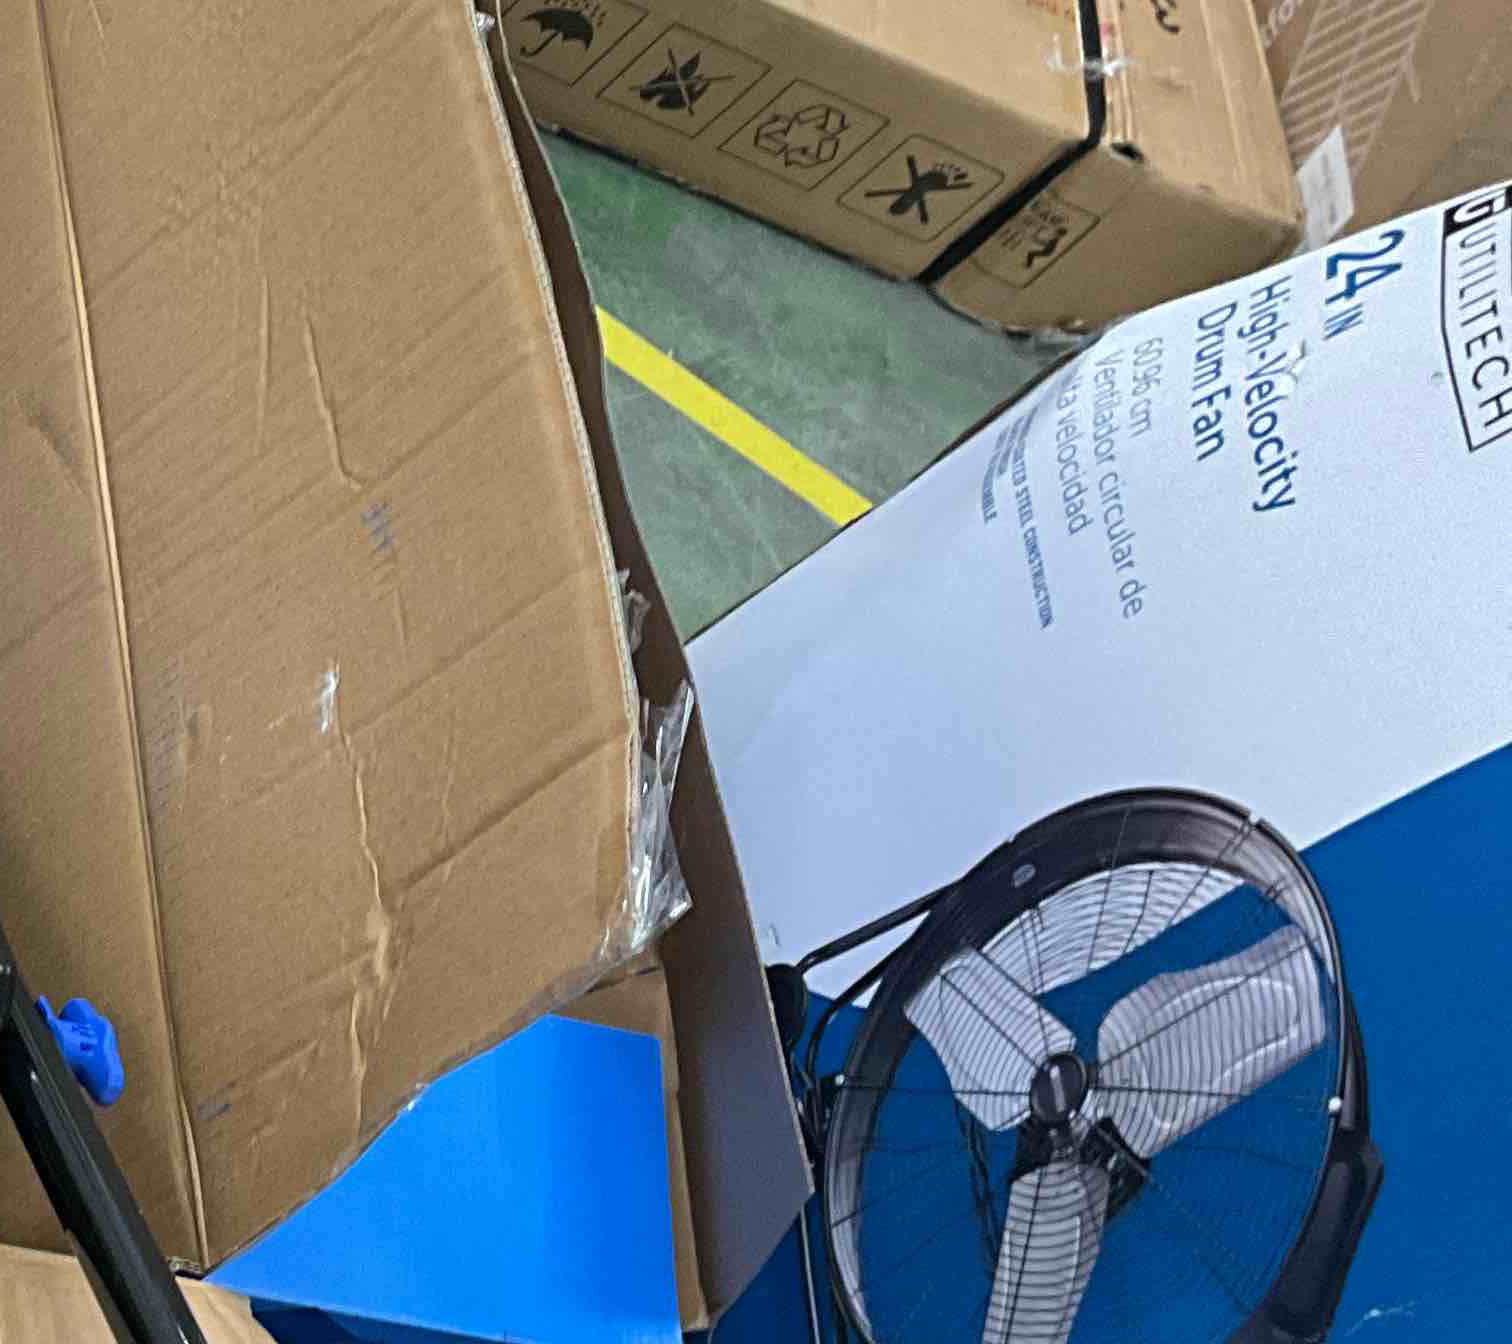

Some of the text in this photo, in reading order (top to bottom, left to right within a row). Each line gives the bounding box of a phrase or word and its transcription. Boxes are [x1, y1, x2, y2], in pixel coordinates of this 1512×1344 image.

[1324, 229, 1406, 341] 24 IN
[1457, 232, 1512, 432] UTILITECH
[1129, 397, 1152, 438] cm
[1191, 302, 1238, 461] Drum Fan
[1237, 275, 1297, 513] High-Velocity
[1055, 413, 1094, 536] velocidad
[1092, 348, 1147, 620] Ventilador circular de
[1023, 526, 1055, 631] CONSTRUCTION
